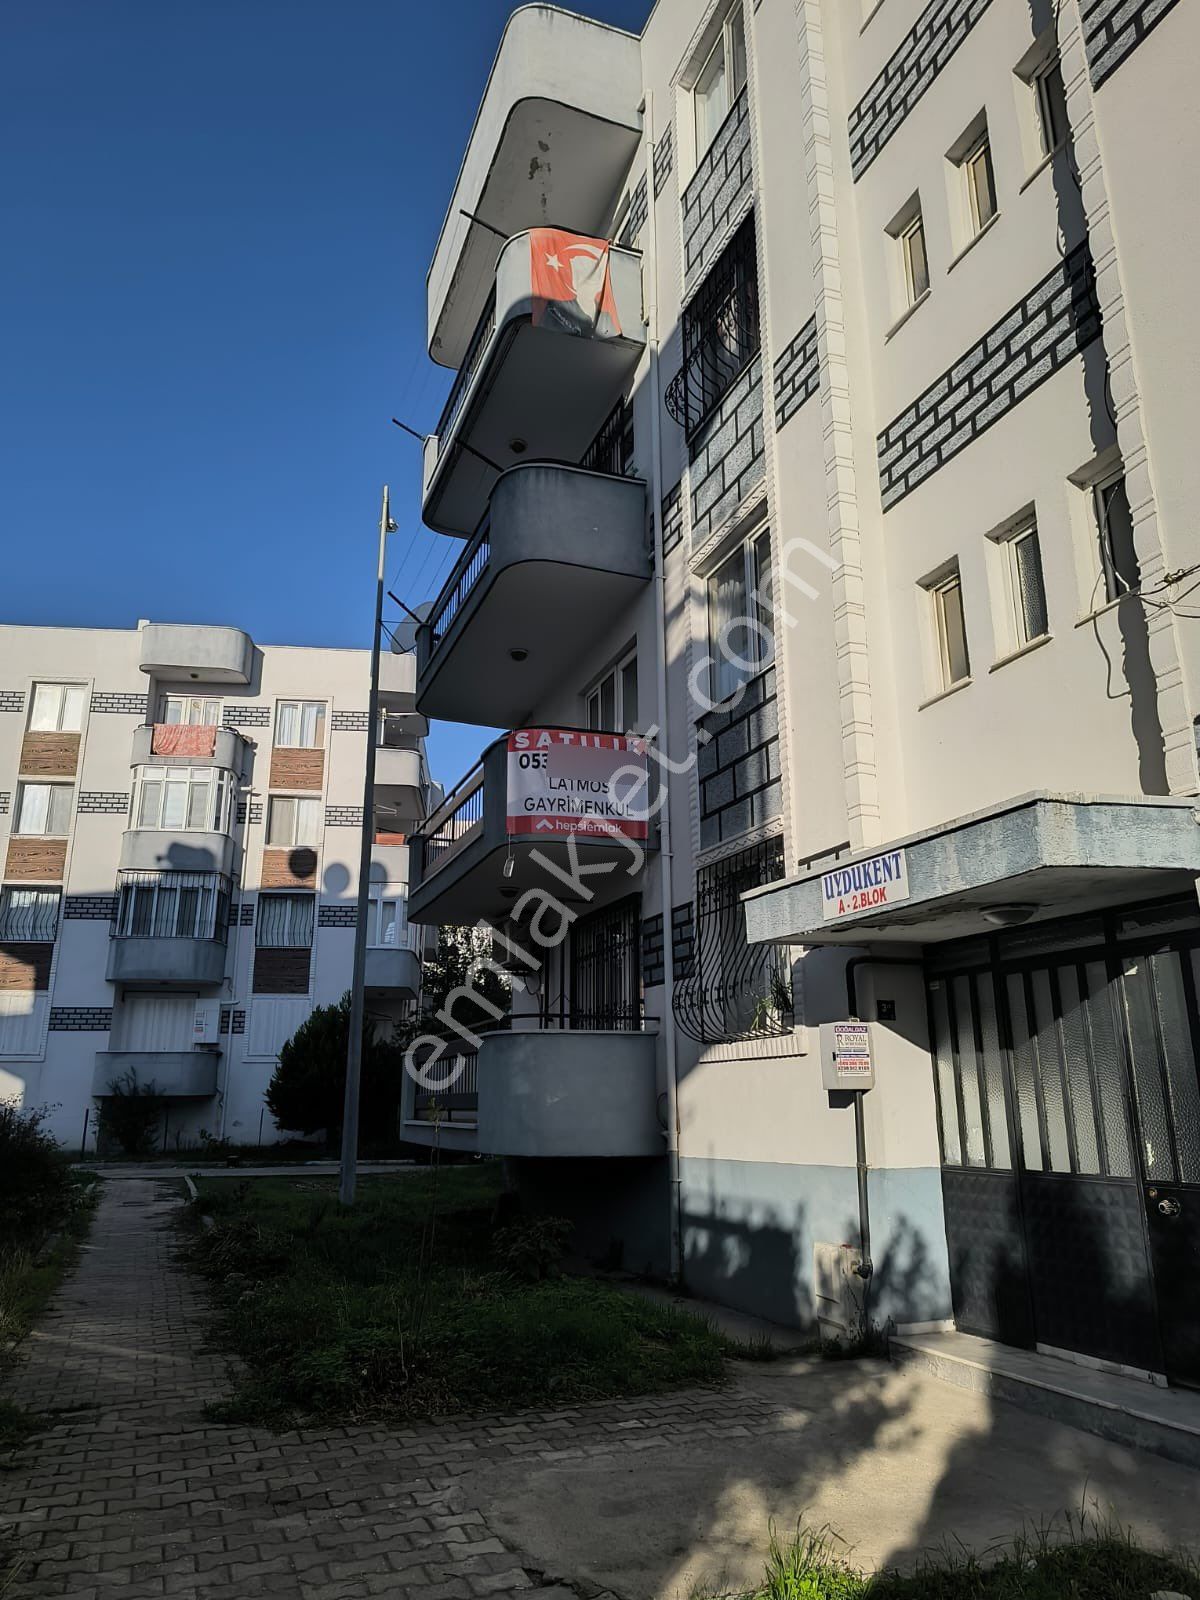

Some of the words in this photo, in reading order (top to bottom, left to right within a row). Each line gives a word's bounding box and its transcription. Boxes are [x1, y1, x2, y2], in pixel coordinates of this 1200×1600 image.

[524, 795, 634, 817] GAYRİMENKUL
[556, 819, 622, 833] hepsiemlak
[824, 852, 902, 900] UYDUKENT
[845, 1034, 867, 1042] ROYAL
